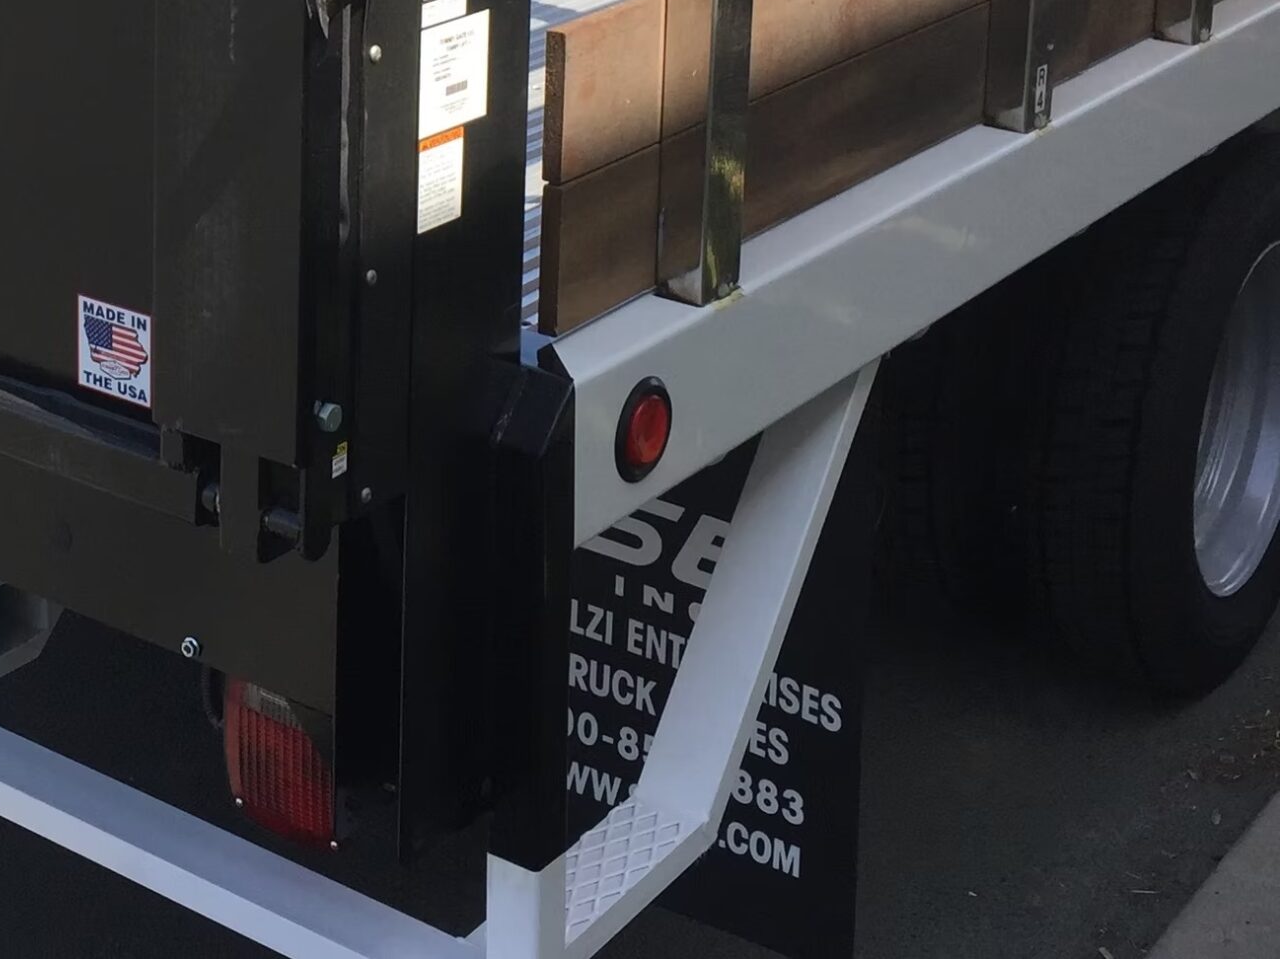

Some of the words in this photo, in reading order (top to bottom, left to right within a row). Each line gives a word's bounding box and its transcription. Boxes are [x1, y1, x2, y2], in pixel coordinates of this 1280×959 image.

[83, 300, 125, 325] MADE
[131, 315, 147, 331] IN
[83, 370, 113, 391] THE
[117, 381, 148, 403] USA
